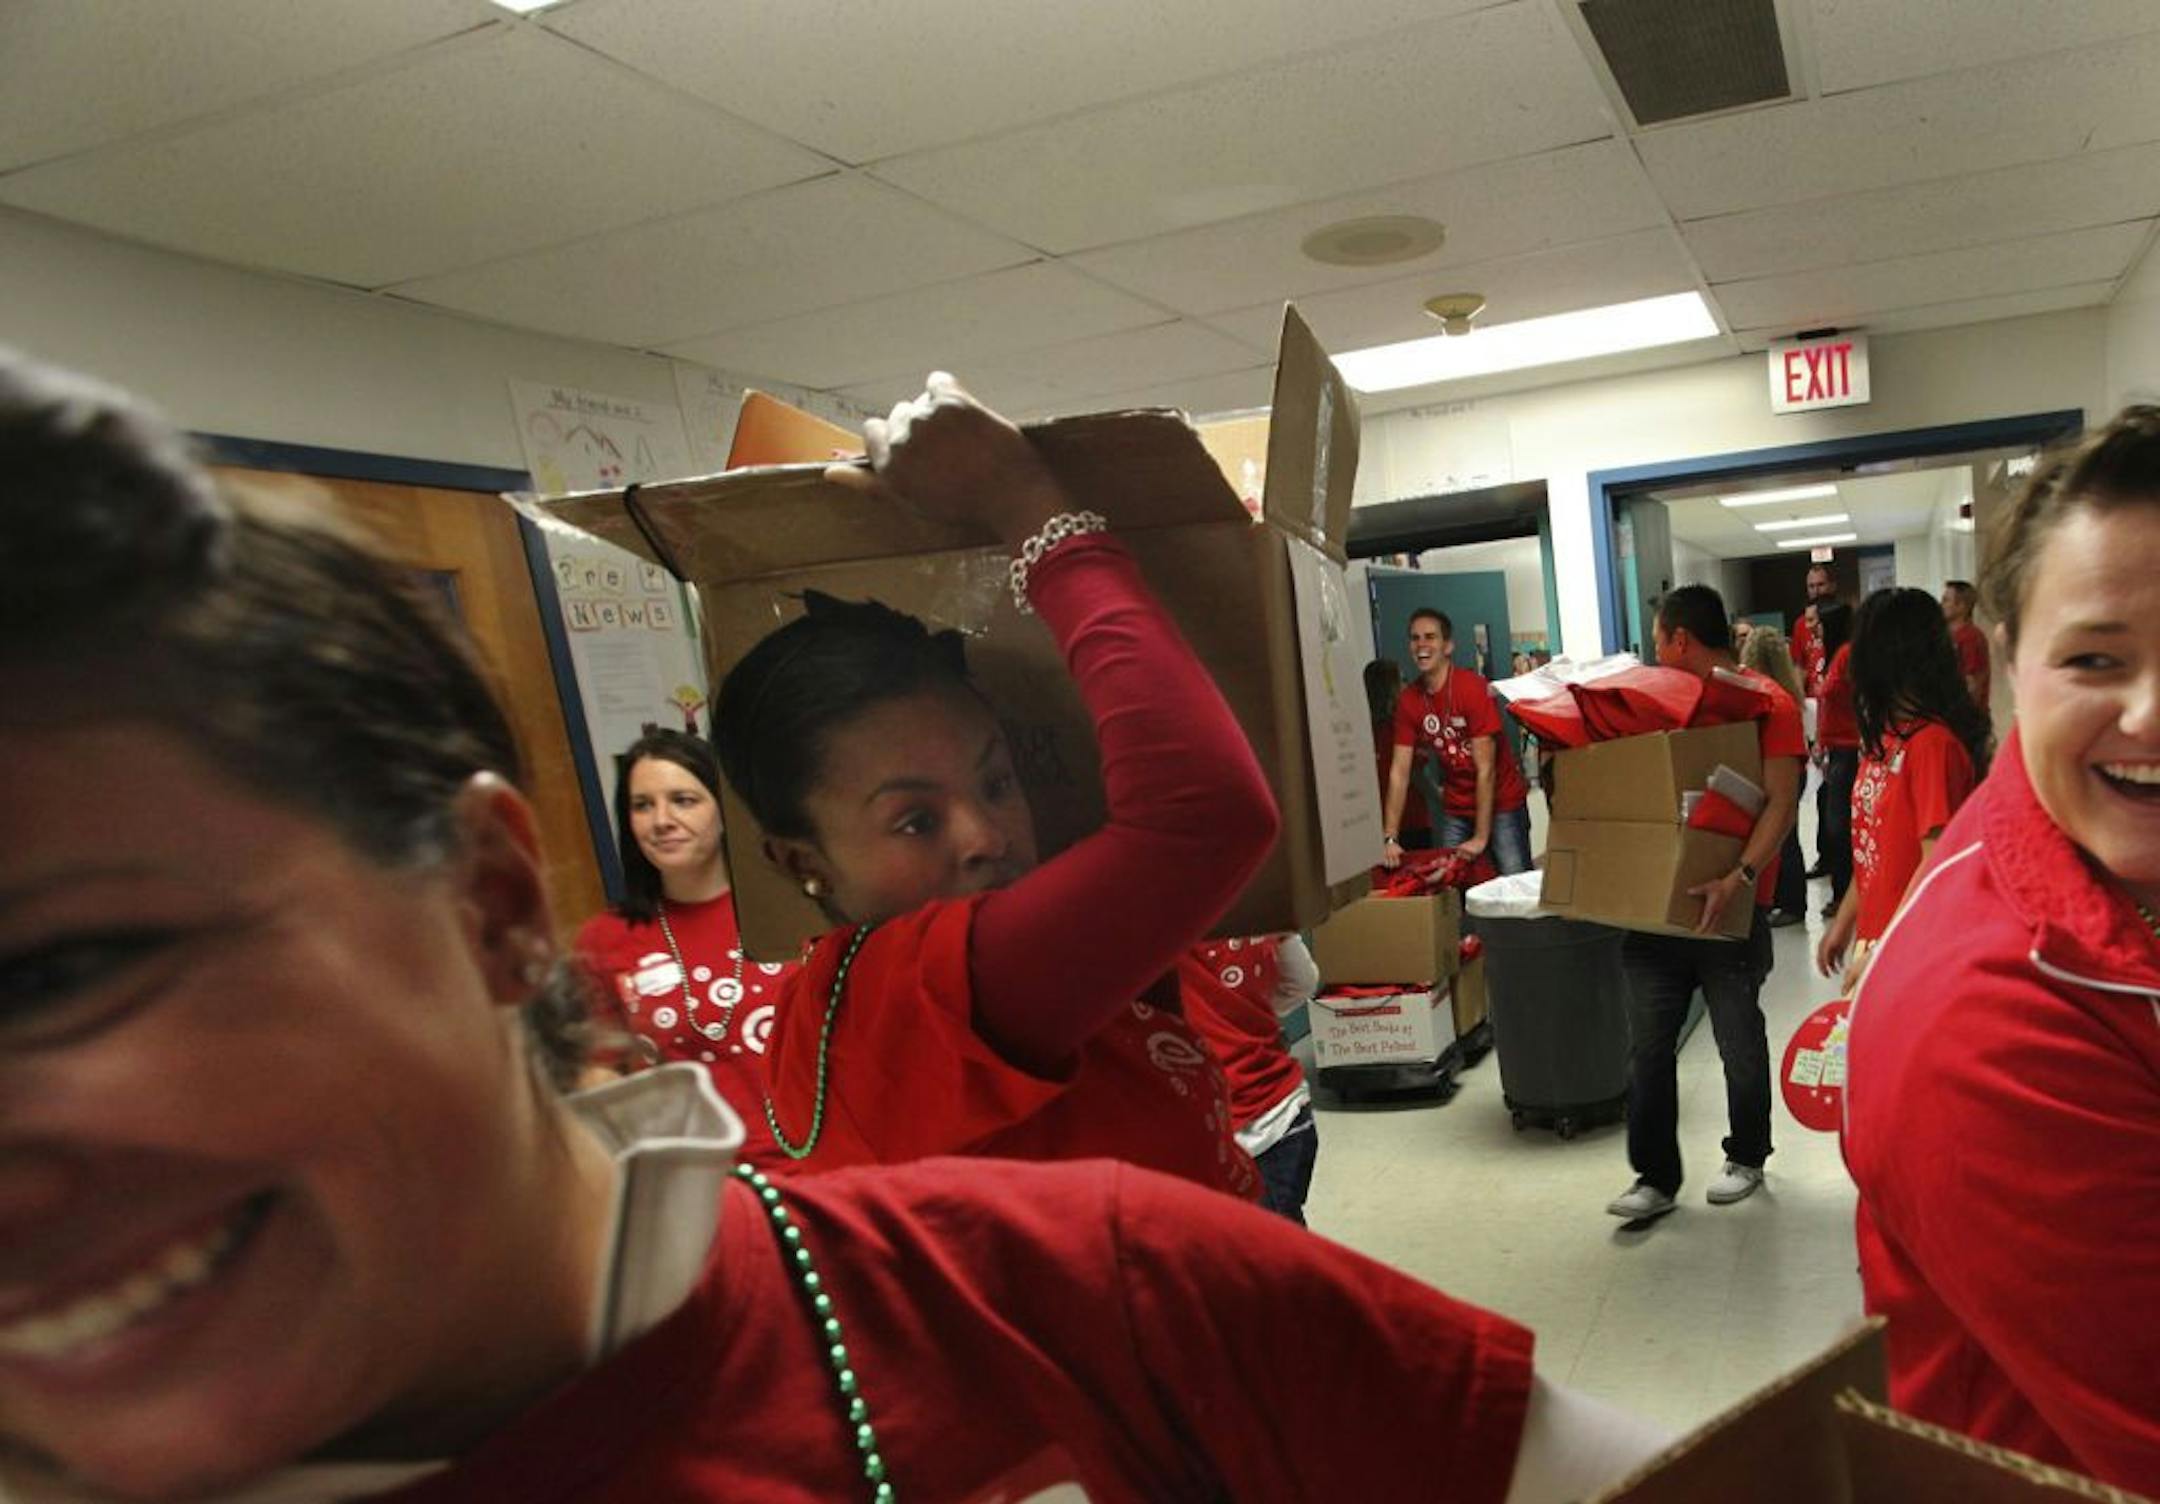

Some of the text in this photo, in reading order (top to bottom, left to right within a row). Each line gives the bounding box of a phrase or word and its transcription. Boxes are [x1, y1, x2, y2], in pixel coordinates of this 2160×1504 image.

[1784, 343, 1852, 403] EXIT
[573, 603, 666, 625] News
[1329, 1042, 1351, 1056] The
